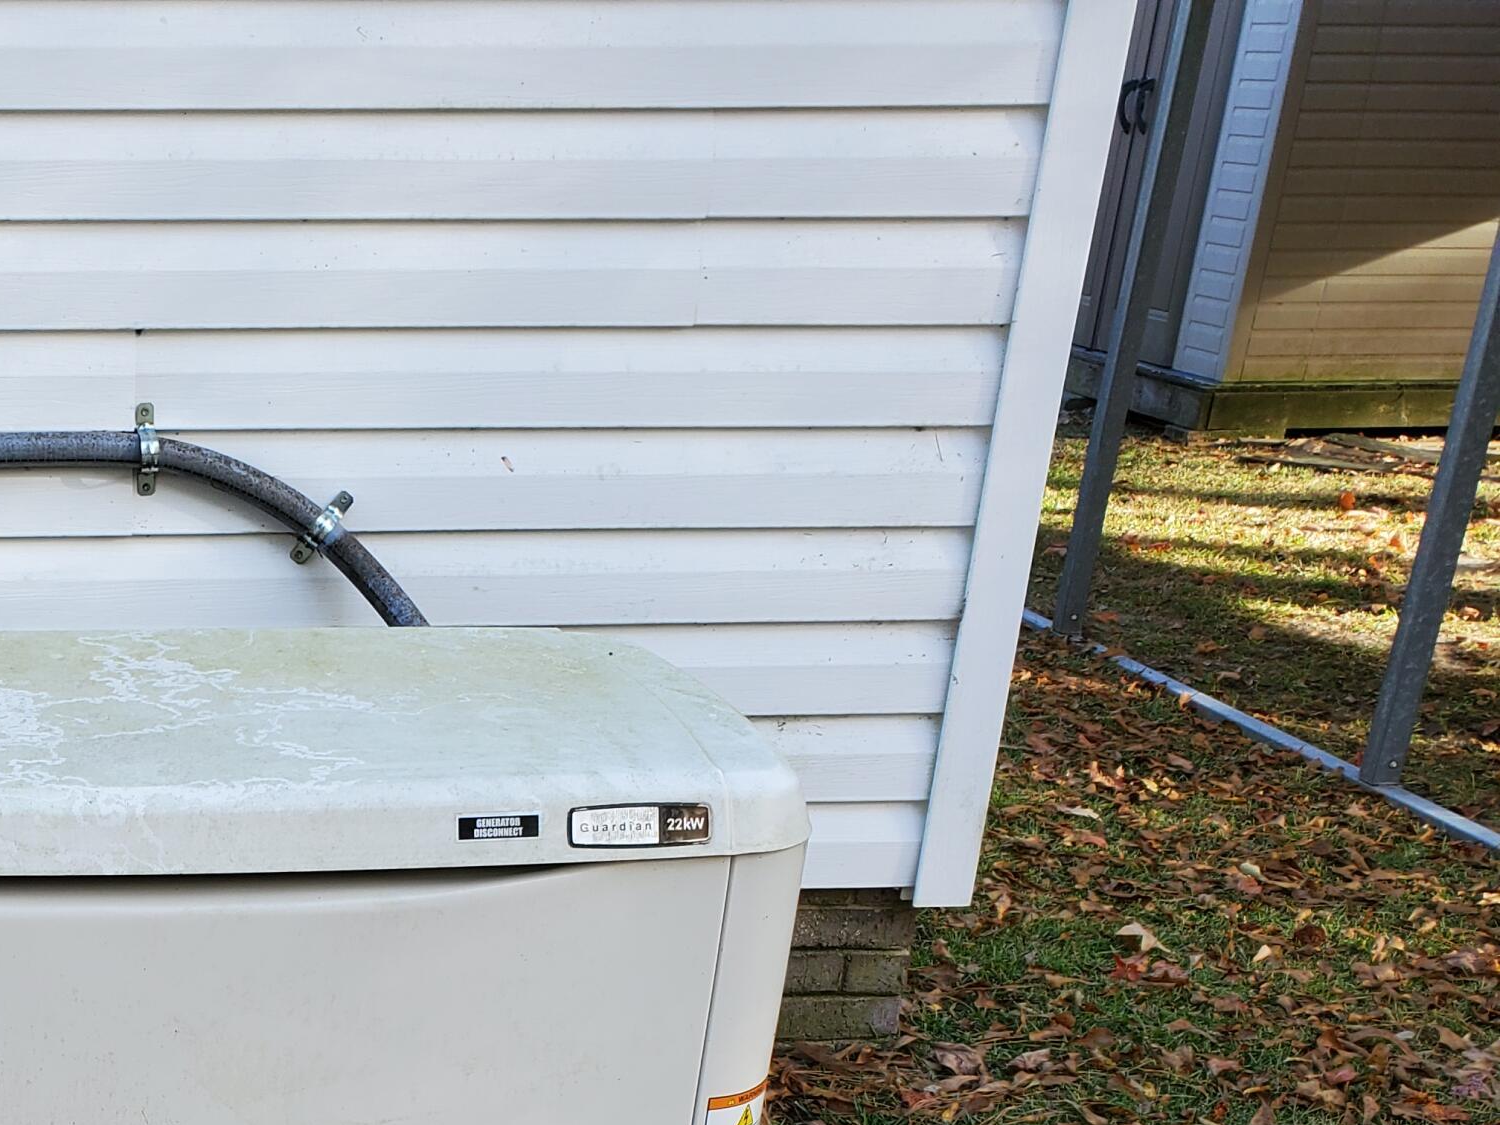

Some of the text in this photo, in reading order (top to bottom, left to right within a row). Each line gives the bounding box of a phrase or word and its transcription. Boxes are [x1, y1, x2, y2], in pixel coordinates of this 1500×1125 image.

[476, 817, 521, 828] GENERATOR
[579, 817, 705, 833] Guardian 22kW
[473, 827, 524, 839] DISCONNECT
